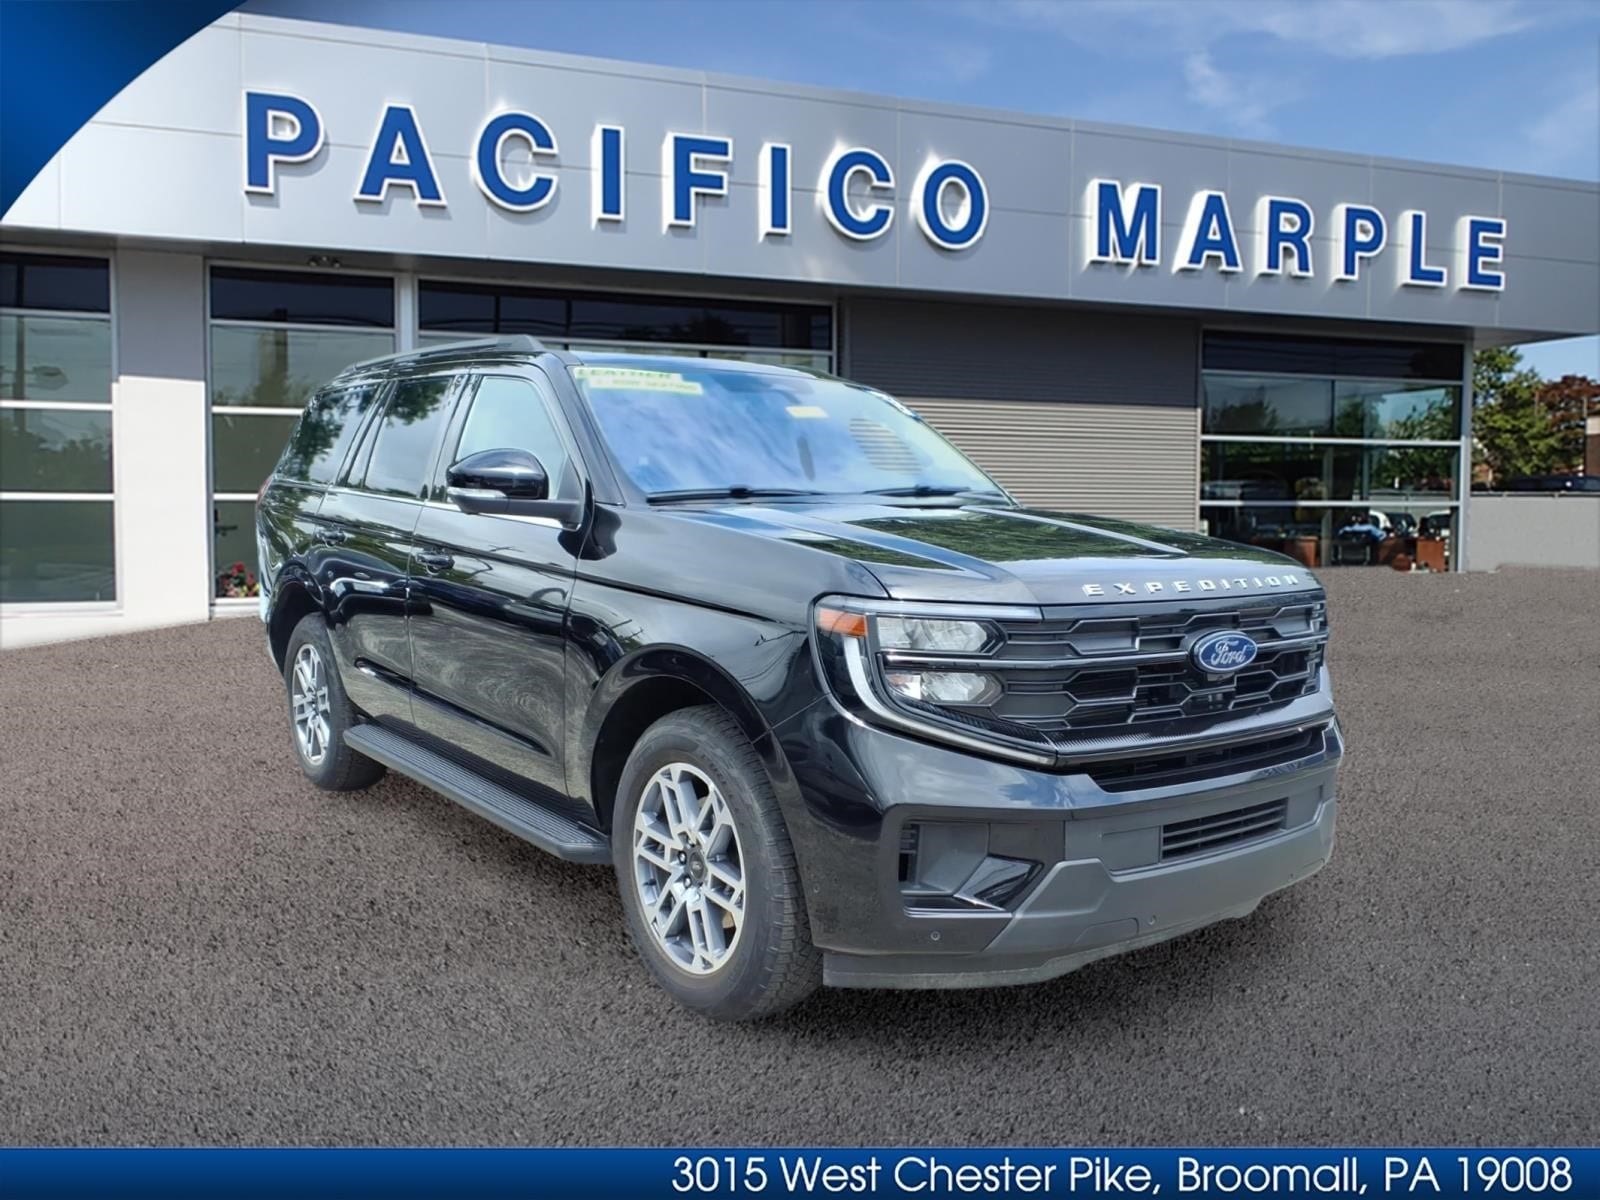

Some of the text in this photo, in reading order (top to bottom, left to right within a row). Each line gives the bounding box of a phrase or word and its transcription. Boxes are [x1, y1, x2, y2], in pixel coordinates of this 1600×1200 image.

[242, 88, 1507, 292] PACIFICO MARPLE
[1082, 574, 1300, 597] EXPEDITION
[1210, 637, 1249, 666] Ford
